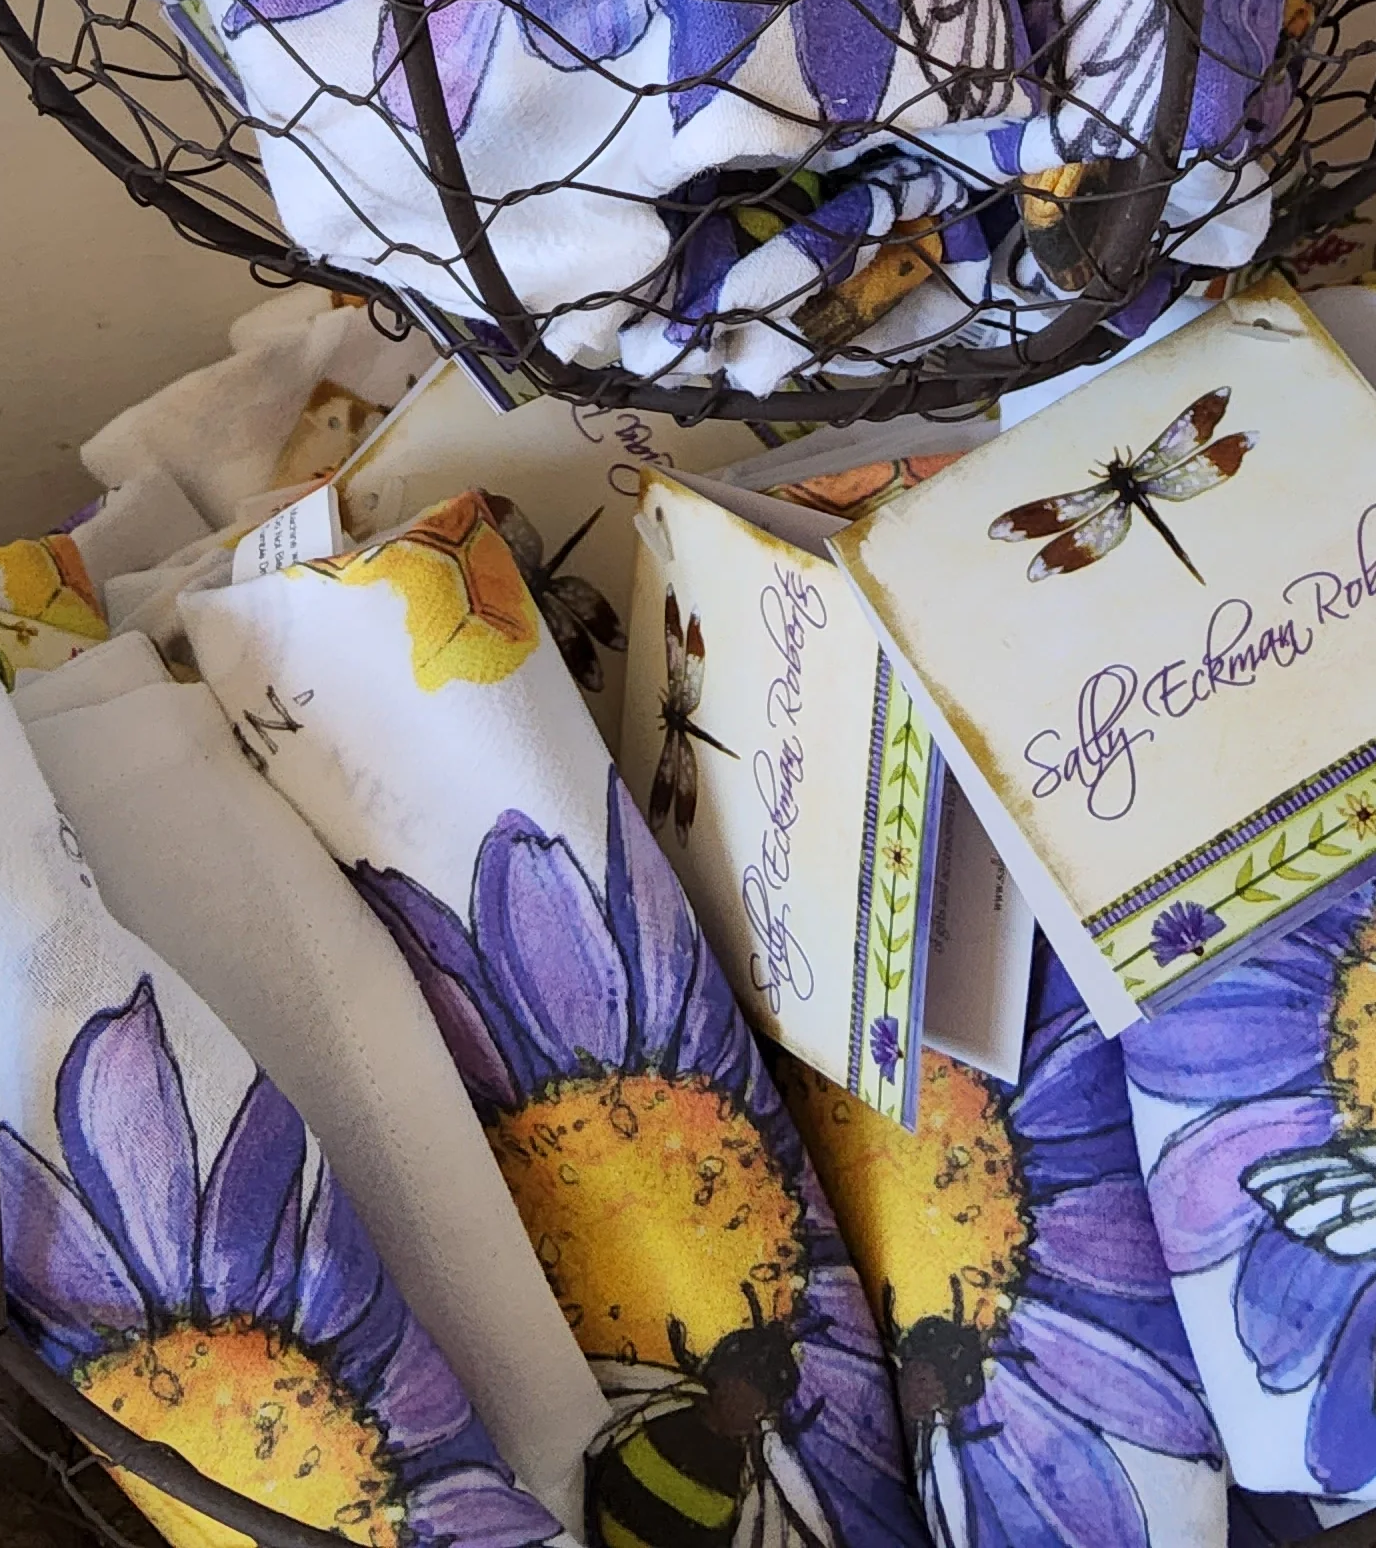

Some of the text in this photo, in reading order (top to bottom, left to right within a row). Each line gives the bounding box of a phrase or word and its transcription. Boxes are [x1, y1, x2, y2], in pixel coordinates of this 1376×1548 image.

[742, 562, 828, 1016] Sally Eckman Roberts
[1024, 664, 1155, 821] Sally
[1142, 599, 1313, 718] Eckman
